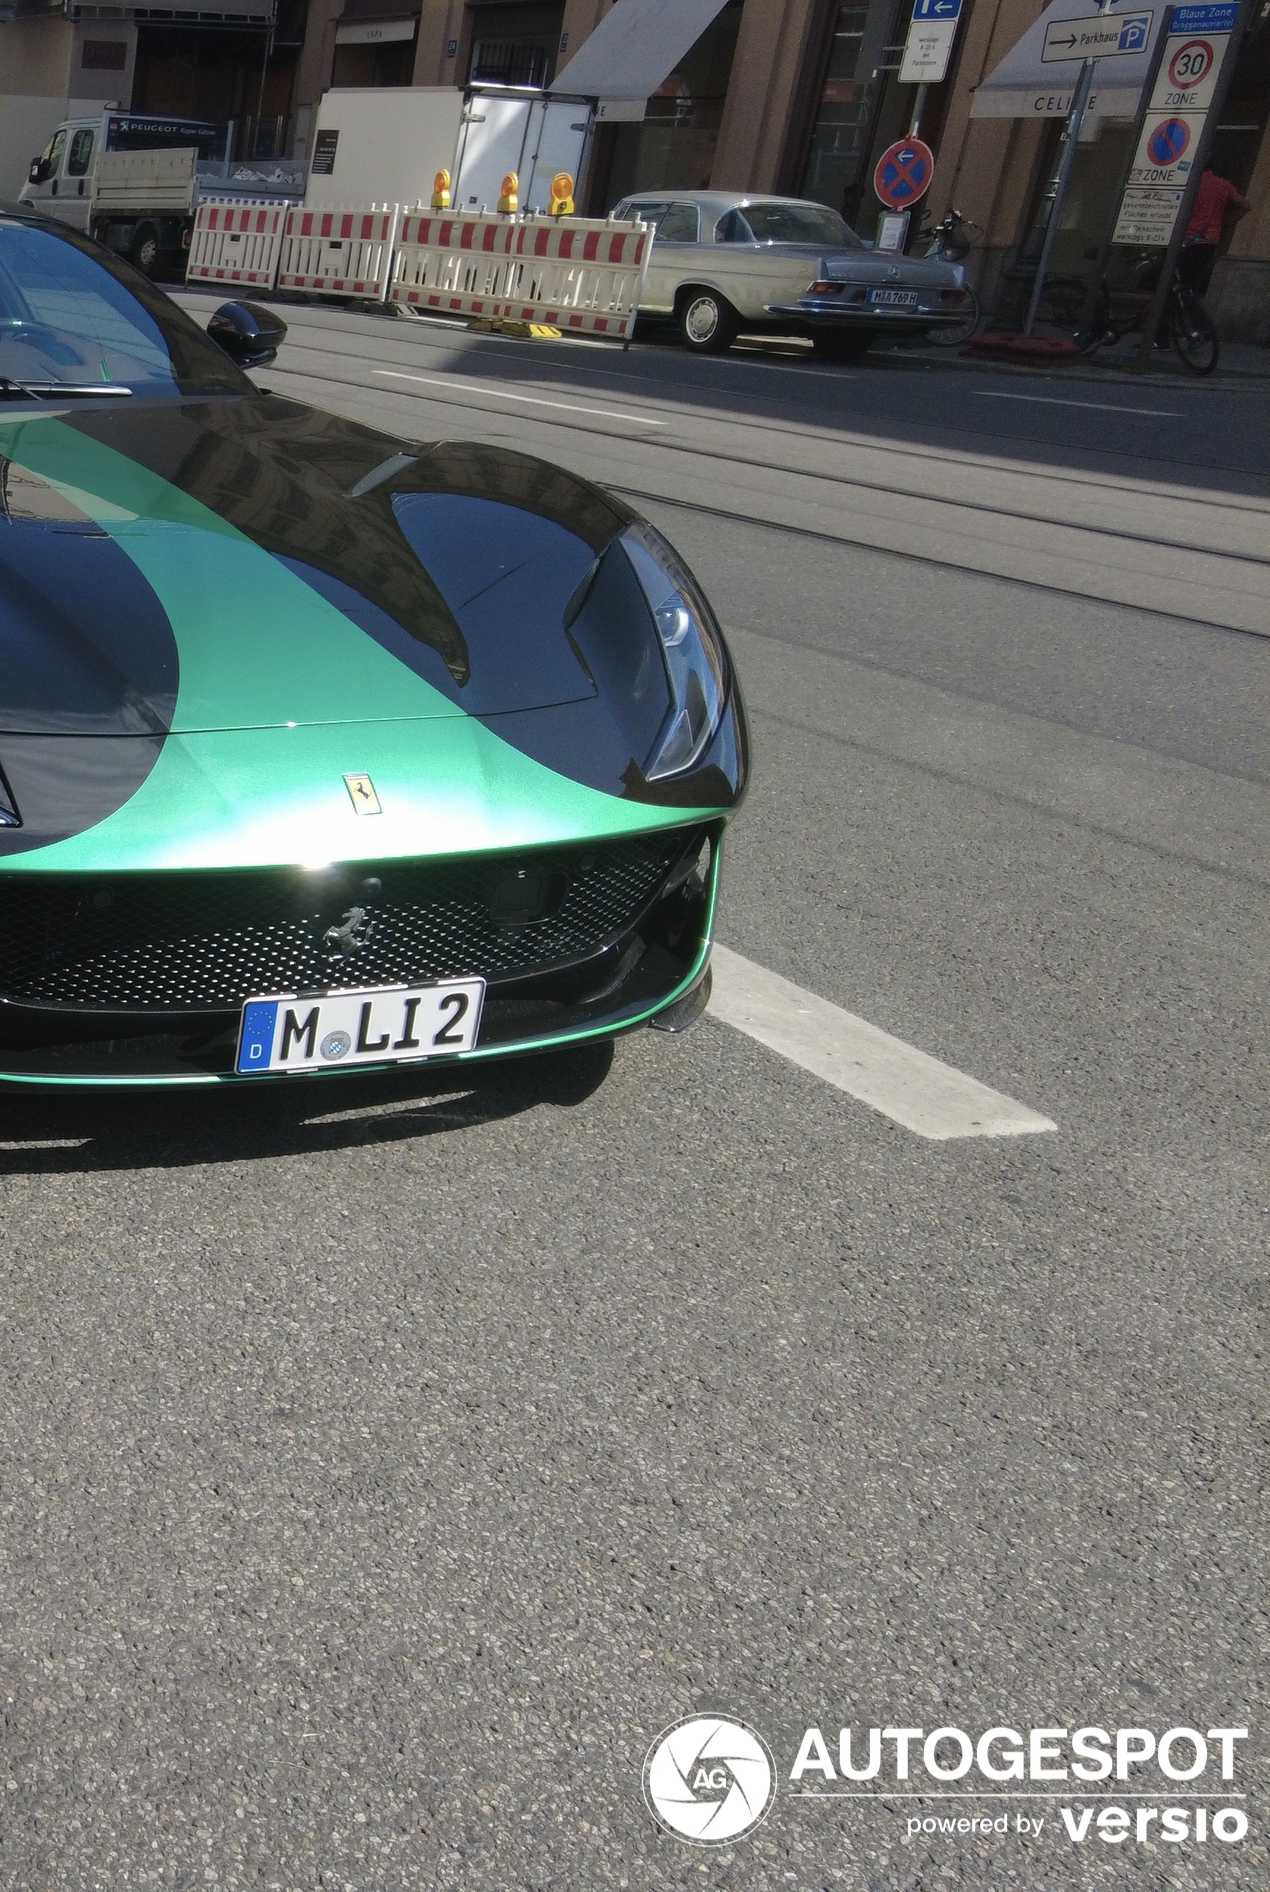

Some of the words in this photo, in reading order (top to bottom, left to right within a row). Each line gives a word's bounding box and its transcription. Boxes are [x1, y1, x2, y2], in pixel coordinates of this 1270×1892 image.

[1179, 9, 1206, 19] Blaue
[1208, 7, 1233, 18] Zone
[1079, 31, 1119, 46] Parkhaus
[1176, 53, 1205, 77] 30
[1034, 96, 1097, 111] CELIE
[1164, 92, 1199, 105] ZONE
[131, 123, 178, 133] PEUGEOT
[1143, 169, 1176, 182] ZONE
[249, 1043, 263, 1060] D
[278, 1005, 322, 1061] M
[355, 997, 423, 1053] LI
[433, 991, 471, 1047] 2
